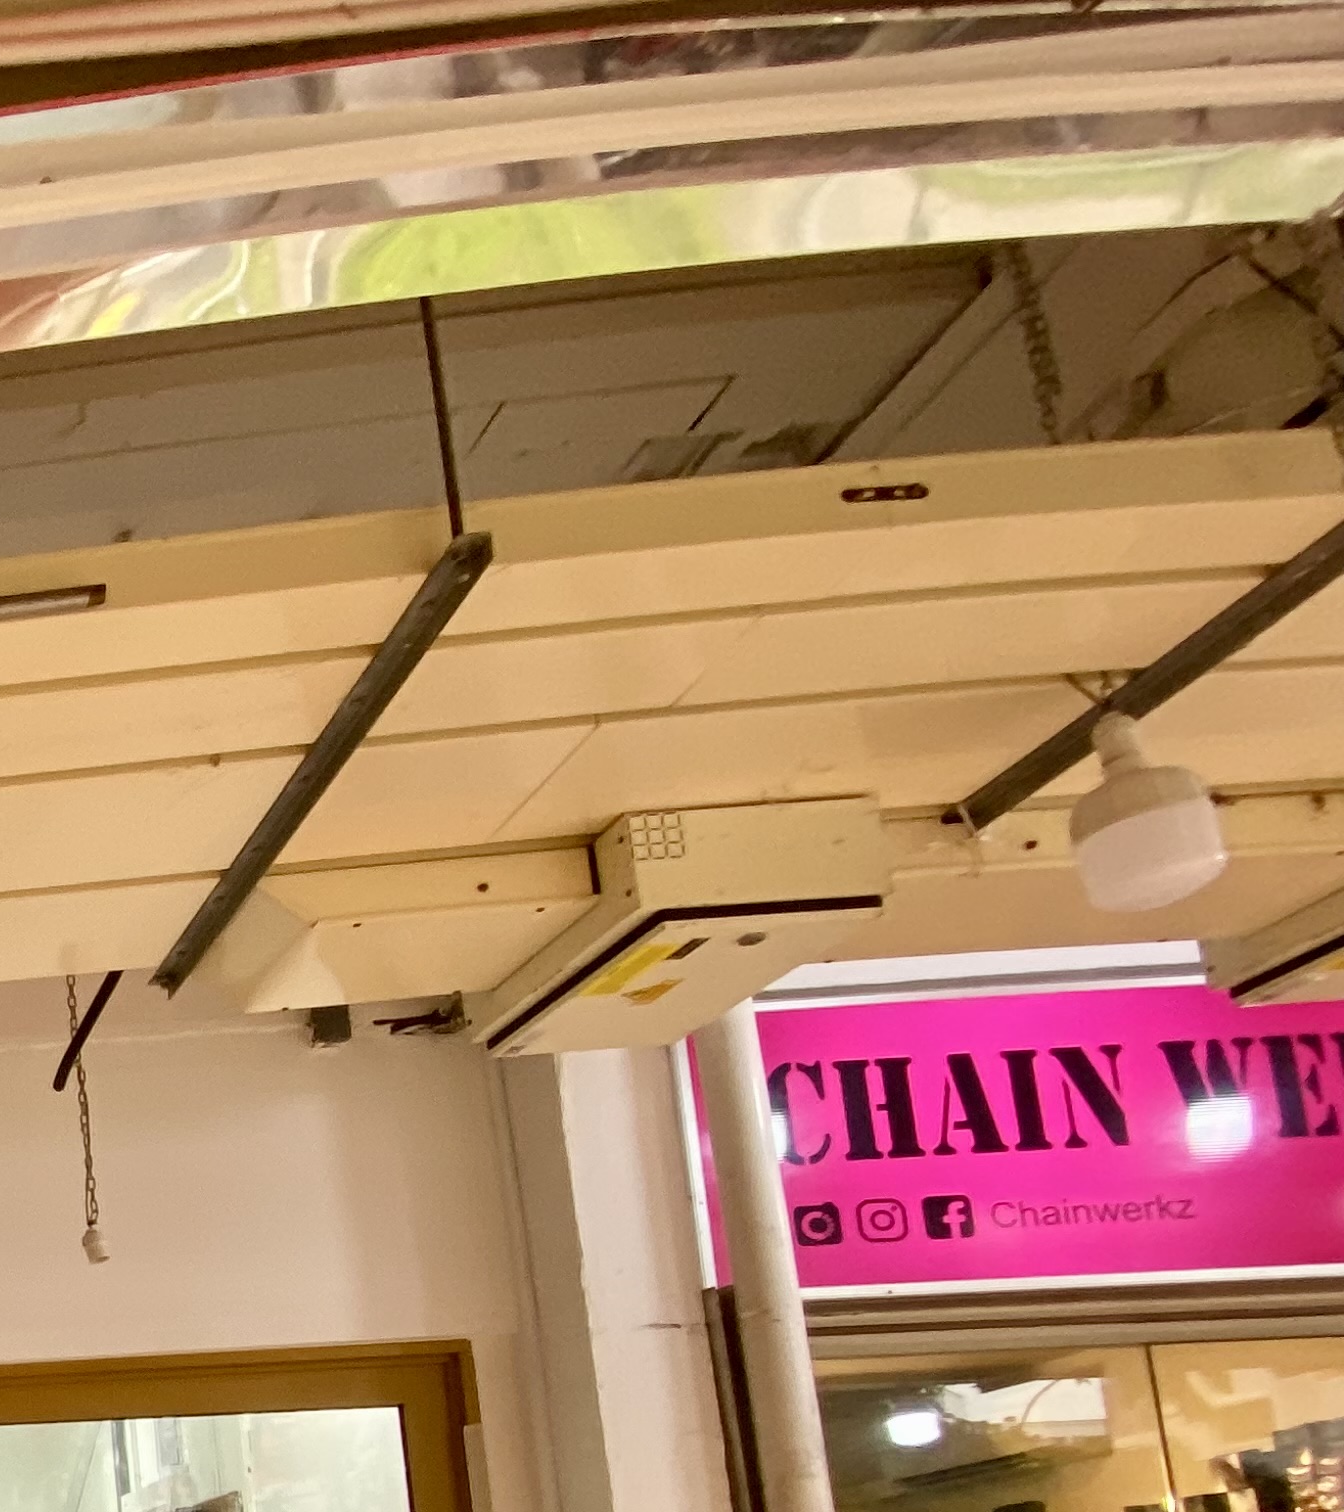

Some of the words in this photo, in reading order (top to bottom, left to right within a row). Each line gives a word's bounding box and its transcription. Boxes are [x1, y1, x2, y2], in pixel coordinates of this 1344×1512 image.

[767, 1044, 1130, 1165] CHAIN
[1157, 1032, 1344, 1139] WE
[990, 1194, 1196, 1230] Chainwerkz
